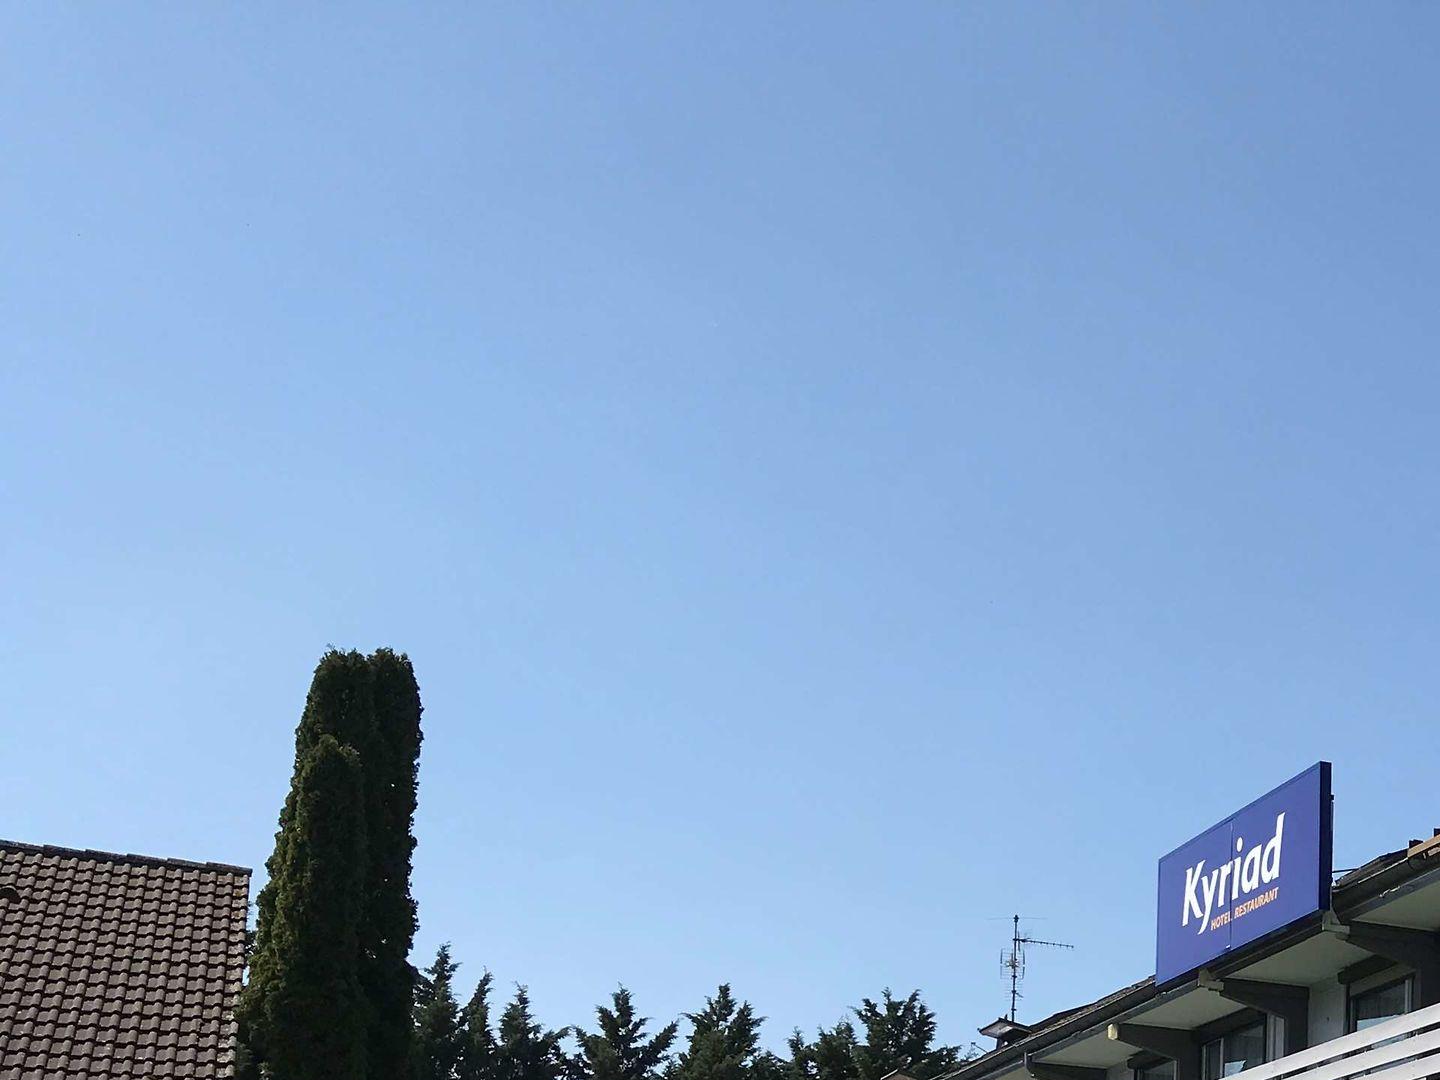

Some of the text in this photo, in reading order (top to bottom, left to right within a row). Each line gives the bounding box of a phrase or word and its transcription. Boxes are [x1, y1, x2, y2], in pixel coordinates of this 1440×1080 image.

[1182, 812, 1286, 935] Kyriad
[1210, 886, 1279, 931] HOTEL RESTAURANT
